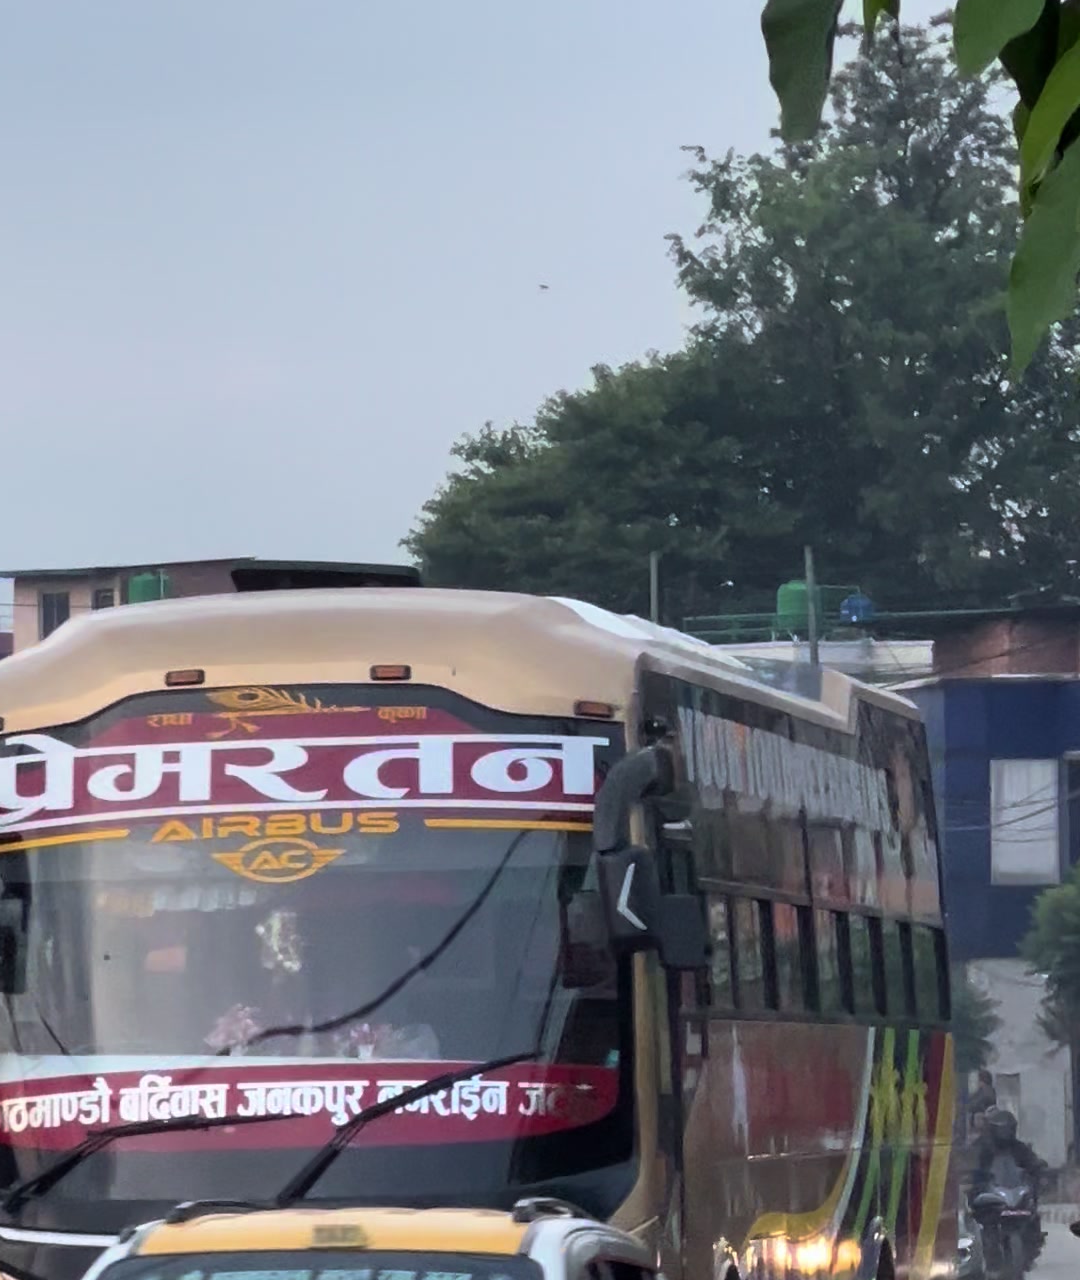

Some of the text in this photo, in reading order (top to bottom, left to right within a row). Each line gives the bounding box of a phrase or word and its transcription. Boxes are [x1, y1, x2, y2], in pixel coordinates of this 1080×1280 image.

[151, 811, 400, 842] AIRBUS
[248, 849, 308, 871] AC
[236, 1079, 370, 1126] जनकपुर
